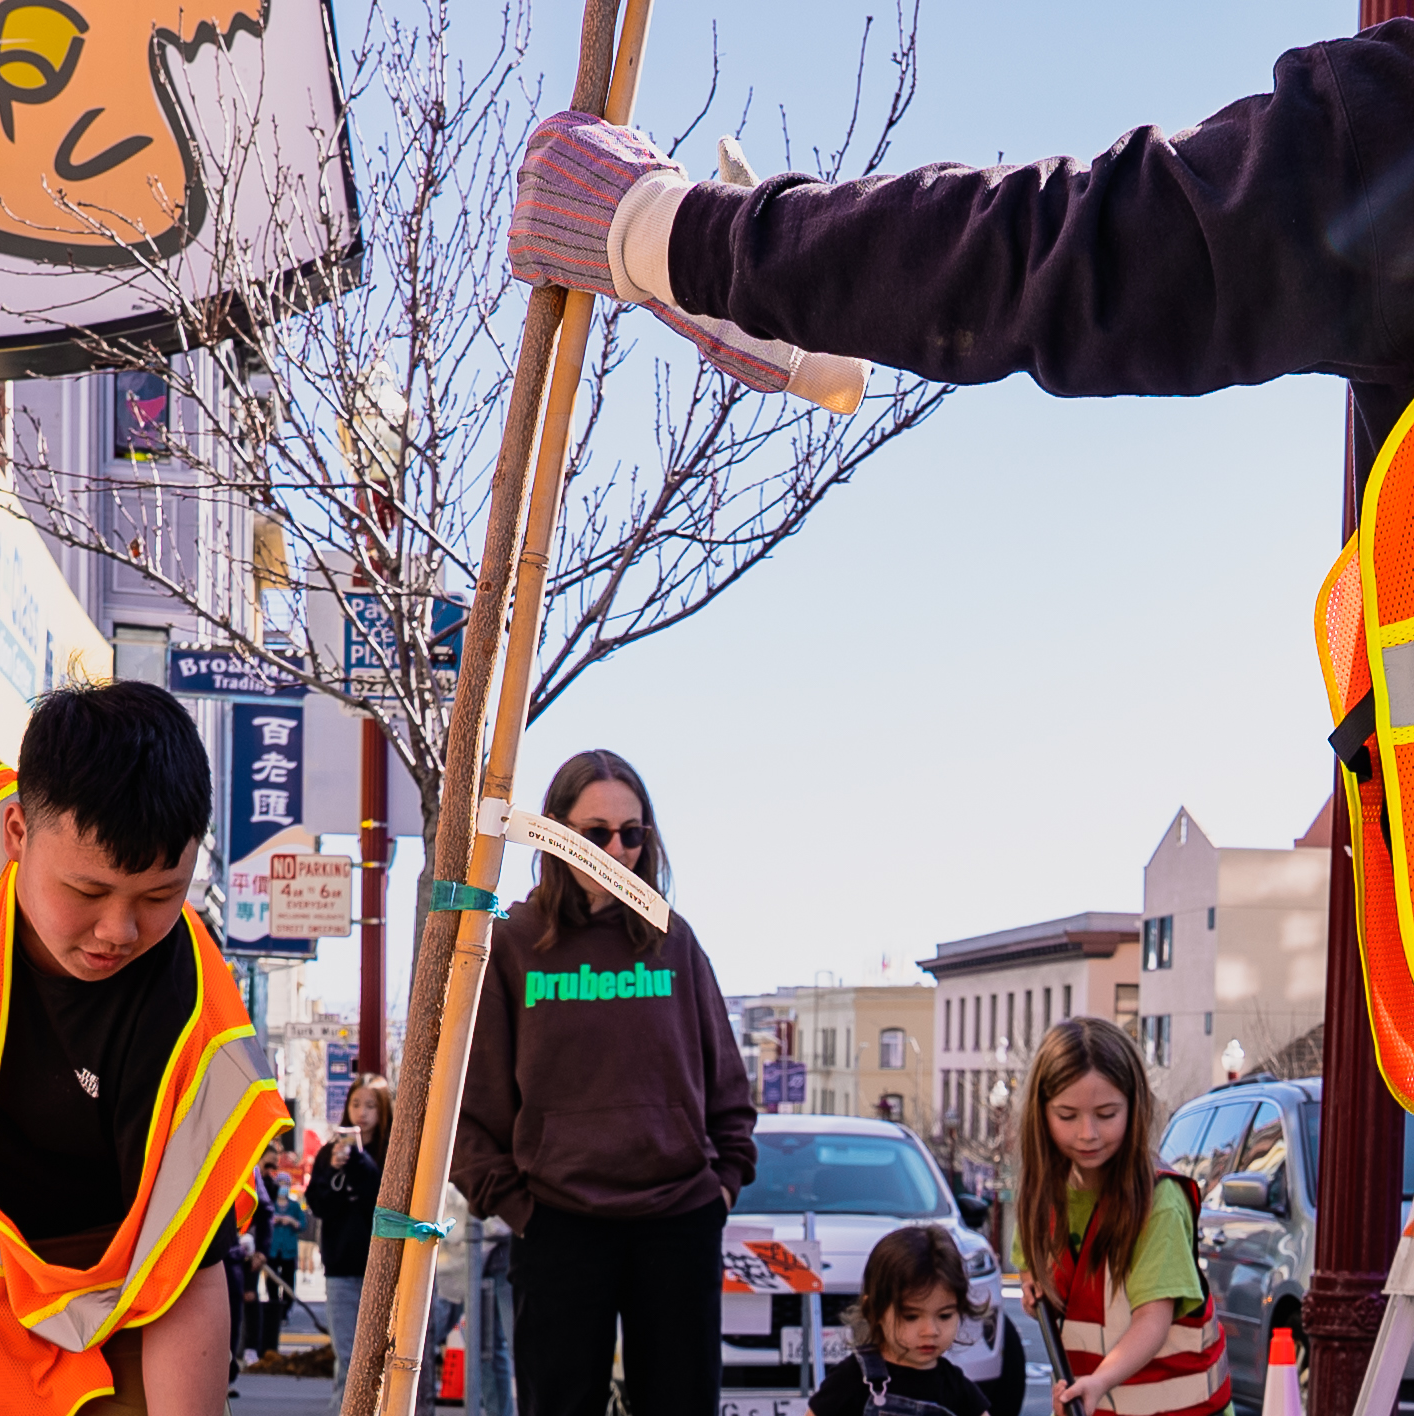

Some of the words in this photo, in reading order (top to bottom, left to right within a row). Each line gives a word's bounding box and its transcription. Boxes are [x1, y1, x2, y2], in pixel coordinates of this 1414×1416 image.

[178, 657, 301, 688] Broadwa
[250, 716, 298, 826] 百老匯
[528, 830, 546, 842] TAG
[548, 838, 566, 849] THIS
[272, 856, 295, 880] NO
[298, 861, 351, 879] PARKING
[568, 848, 597, 872] REMOVE
[598, 869, 613, 884] NOT
[280, 883, 292, 898] 4
[319, 883, 331, 899] 6
[625, 888, 650, 912] PLEASE
[525, 962, 672, 1008] prubechu
